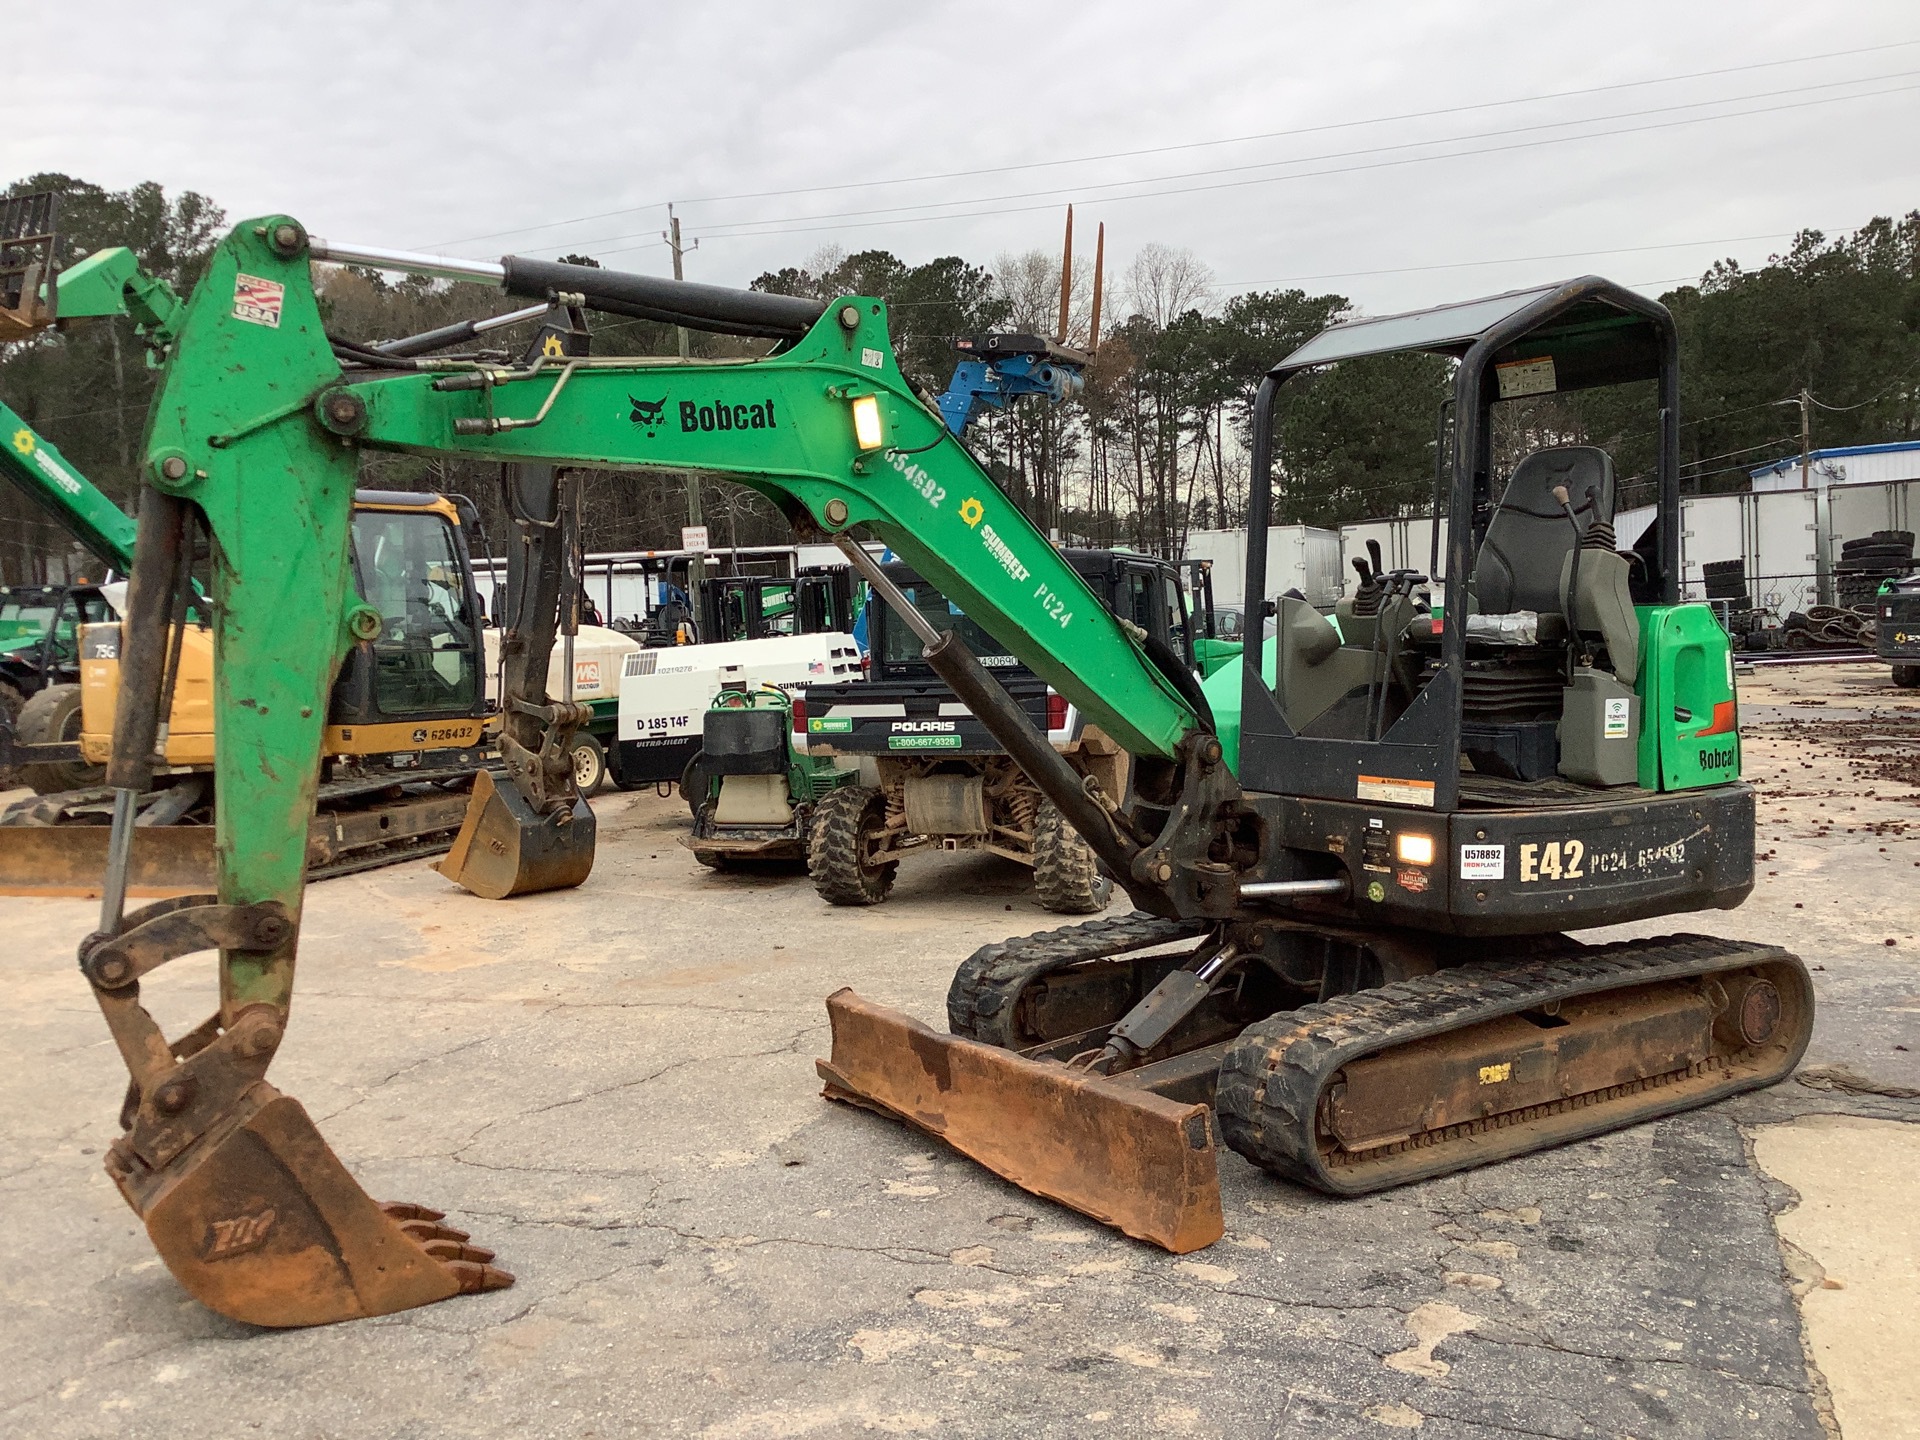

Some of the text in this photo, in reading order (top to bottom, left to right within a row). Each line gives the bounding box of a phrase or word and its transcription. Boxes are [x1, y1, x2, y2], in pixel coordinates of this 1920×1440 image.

[235, 304, 276, 323] USA
[679, 399, 776, 433] Bobcat
[980, 524, 1031, 582] SUNBELT
[982, 540, 1017, 580] RENTALS
[1033, 582, 1073, 628] PC24
[95, 643, 116, 658] 75G
[576, 663, 600, 681] MQ
[637, 715, 689, 730] D 185 T4F
[891, 721, 956, 732] POLARIS
[431, 727, 473, 741] 626432
[636, 738, 690, 748] ULTRA-SILENT
[895, 737, 955, 747] 1-800-667-9328
[1699, 746, 1734, 771] Bobcat
[1465, 850, 1501, 859] U578892
[1520, 840, 1584, 882] E42
[1589, 850, 1627, 874] PC24
